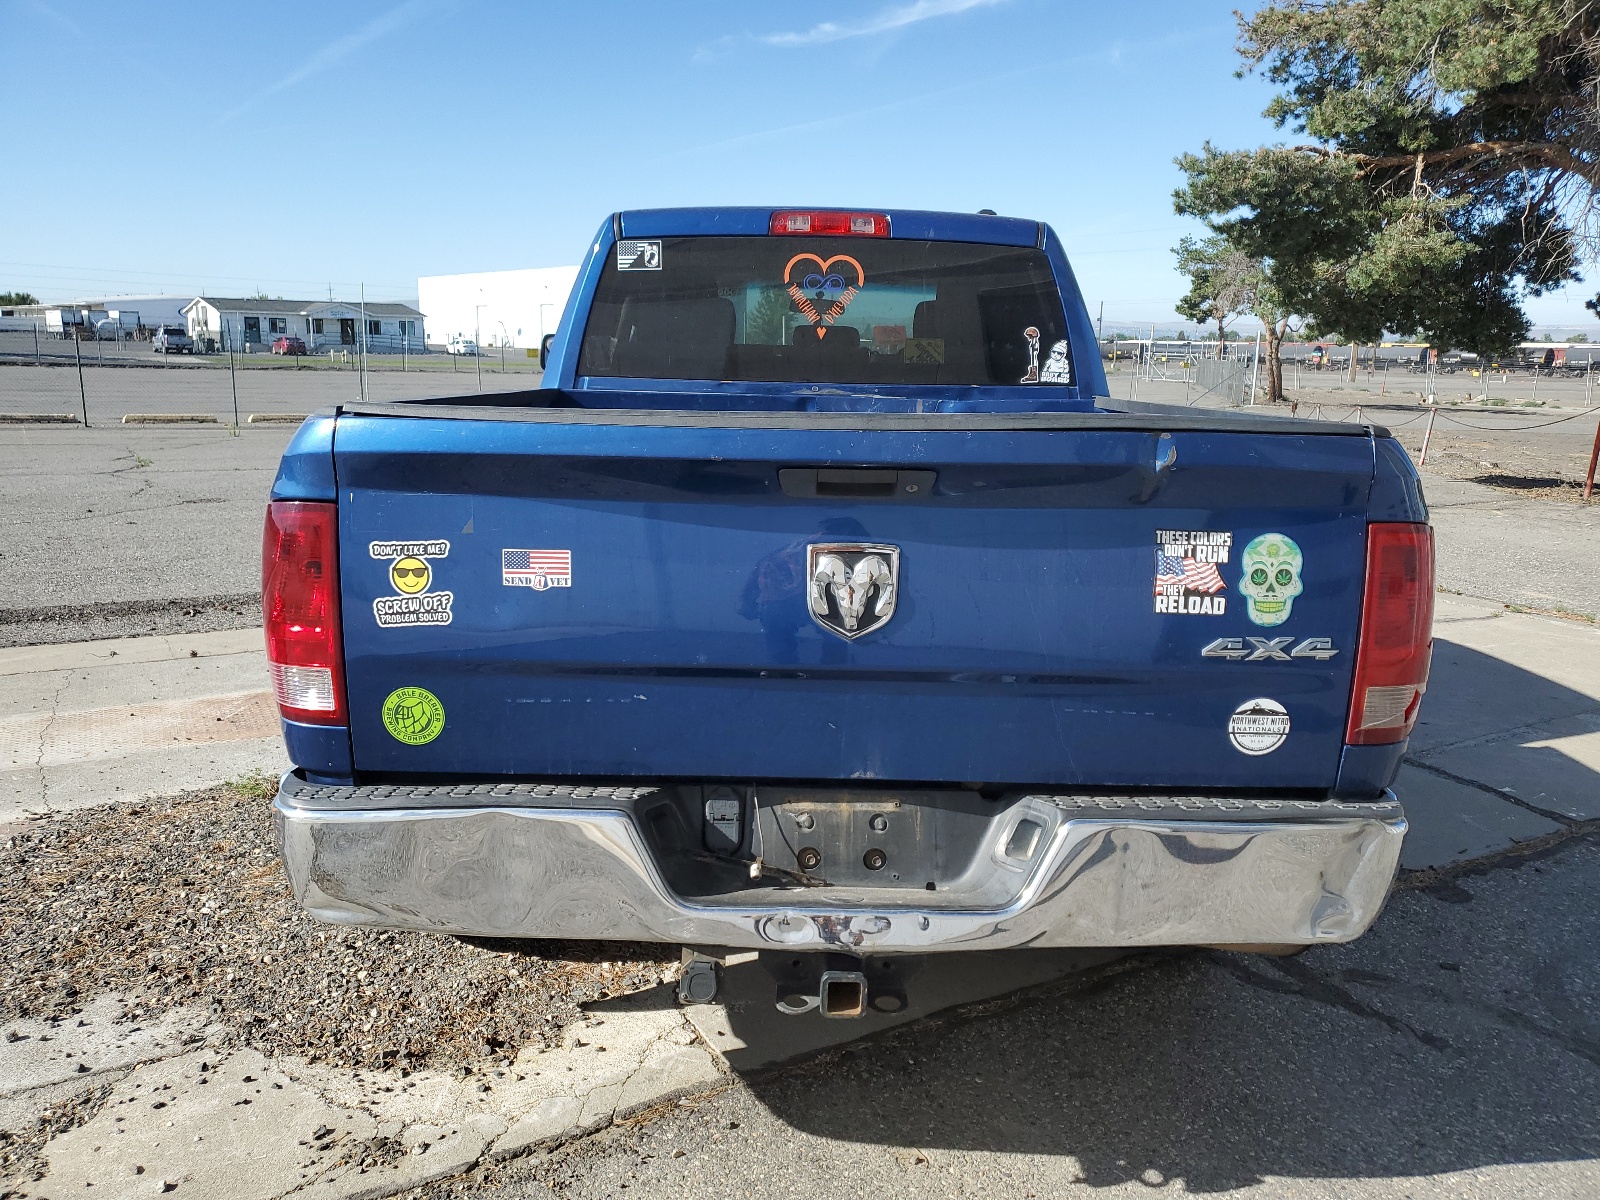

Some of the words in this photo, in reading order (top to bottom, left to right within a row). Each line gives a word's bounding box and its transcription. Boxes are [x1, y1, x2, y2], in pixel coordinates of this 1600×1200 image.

[786, 282, 820, 324] JONATHAN
[1156, 530, 1189, 544] THESE
[1190, 531, 1231, 545] COLORS
[373, 544, 402, 555] DON'T
[404, 544, 425, 555] LIKE
[427, 543, 446, 554] ME?
[1164, 544, 1193, 557] DON'T
[1196, 545, 1228, 563] RUN
[504, 576, 532, 585] SEND
[549, 577, 570, 586] VET
[1162, 584, 1186, 595] THEY
[377, 598, 420, 614] SCREW
[422, 595, 451, 610] OFF
[1155, 595, 1226, 615] RELOAD
[380, 613, 417, 623] PROBLEM
[418, 612, 449, 622] SOLVED
[395, 690, 417, 699] BALE
[418, 691, 441, 723] BREAKER
[386, 707, 401, 736] BREWING
[402, 729, 435, 741] COMPANY
[1231, 717, 1269, 726] NORTHWEST
[1270, 717, 1289, 726] NITRO
